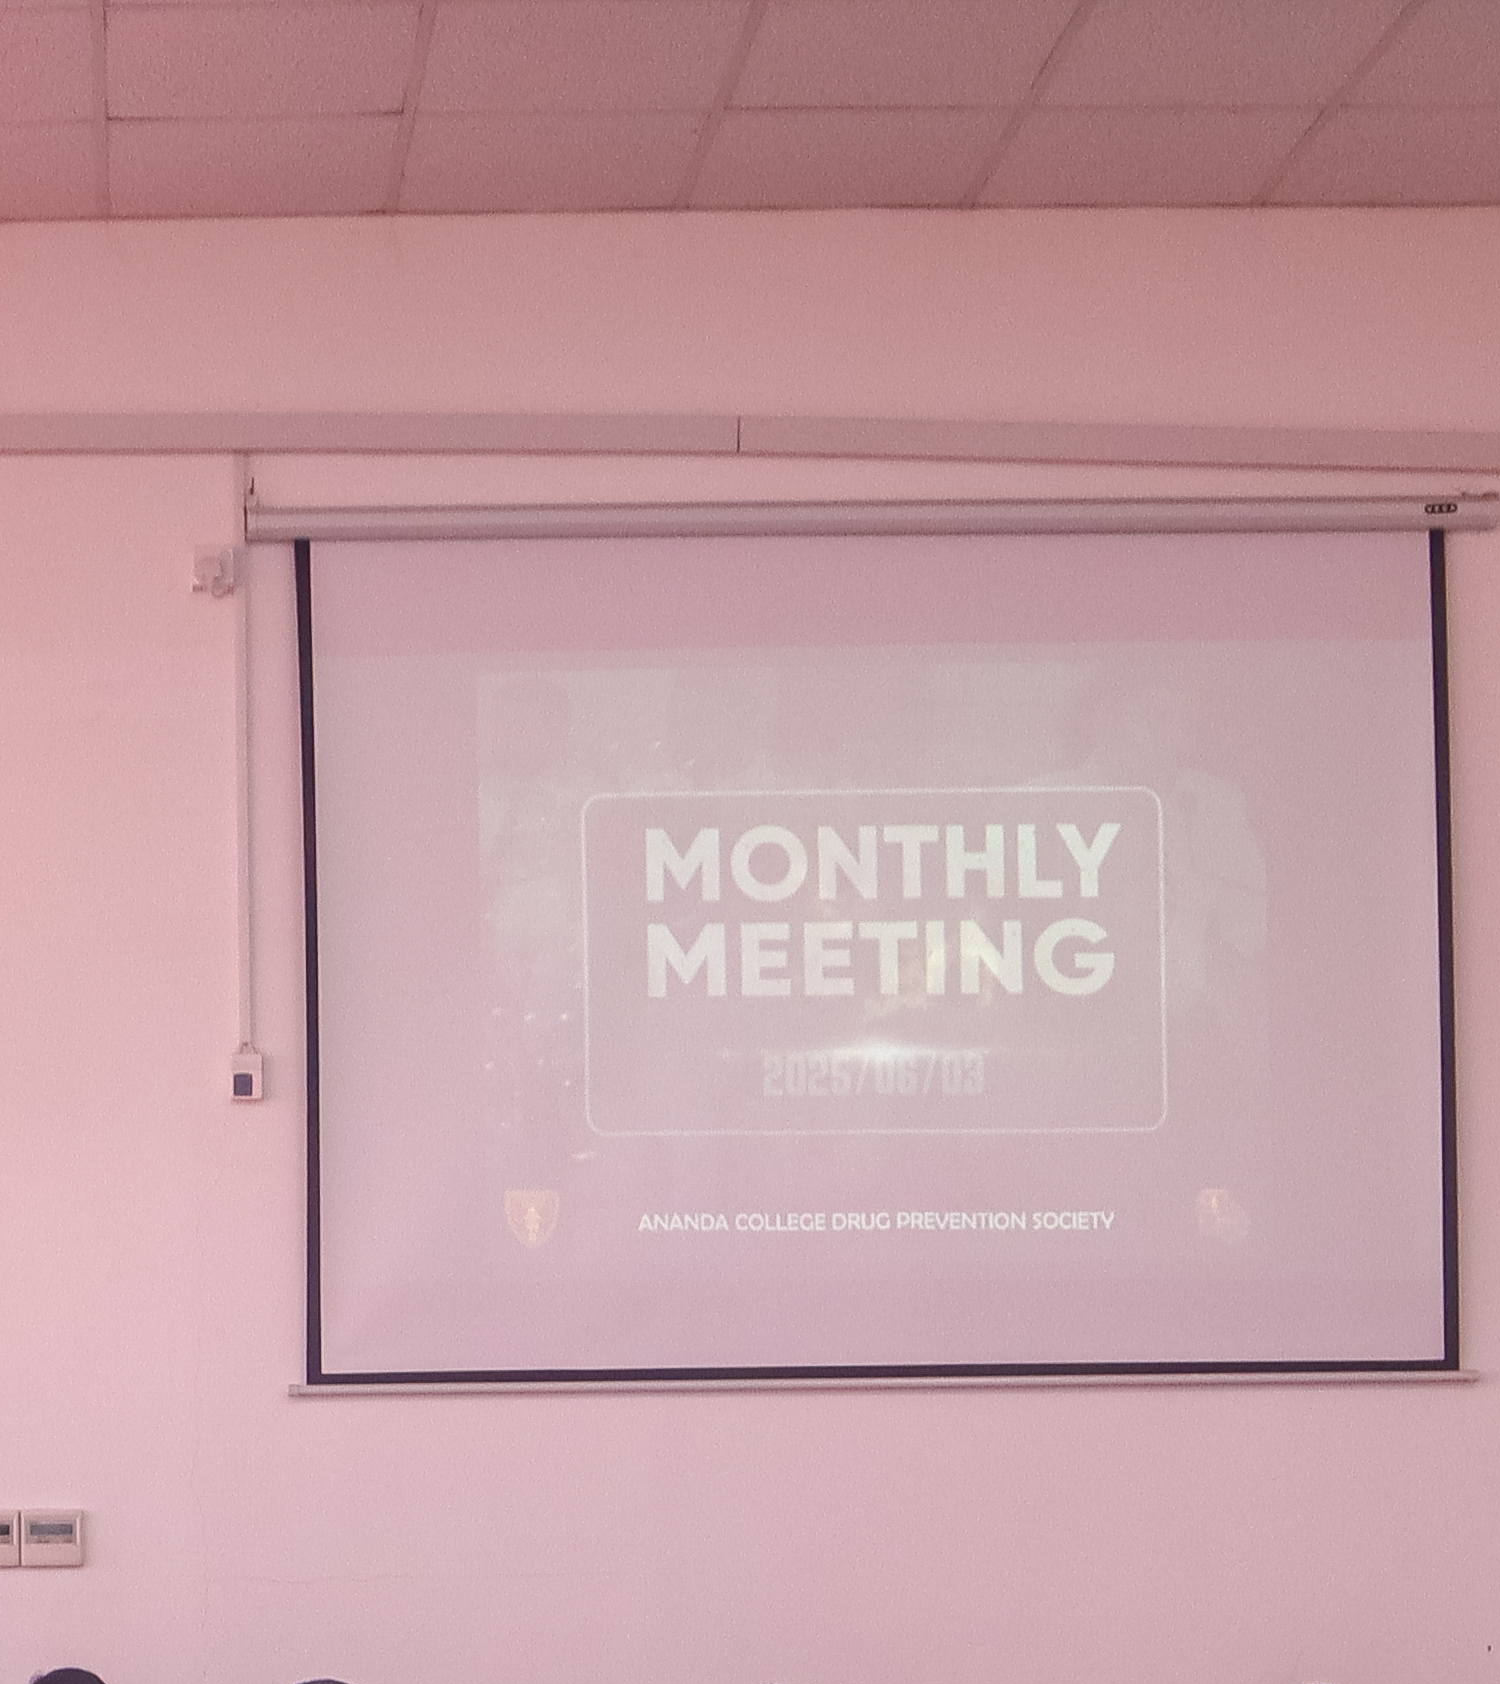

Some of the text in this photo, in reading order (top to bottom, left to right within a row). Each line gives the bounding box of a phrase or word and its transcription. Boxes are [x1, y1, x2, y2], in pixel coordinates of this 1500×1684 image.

[644, 822, 1123, 902] MONTHLY
[645, 916, 1117, 999] MEETING
[638, 1210, 1116, 1232] ANANDA COLLEGE DRUG PREVENTION SOCIETY
